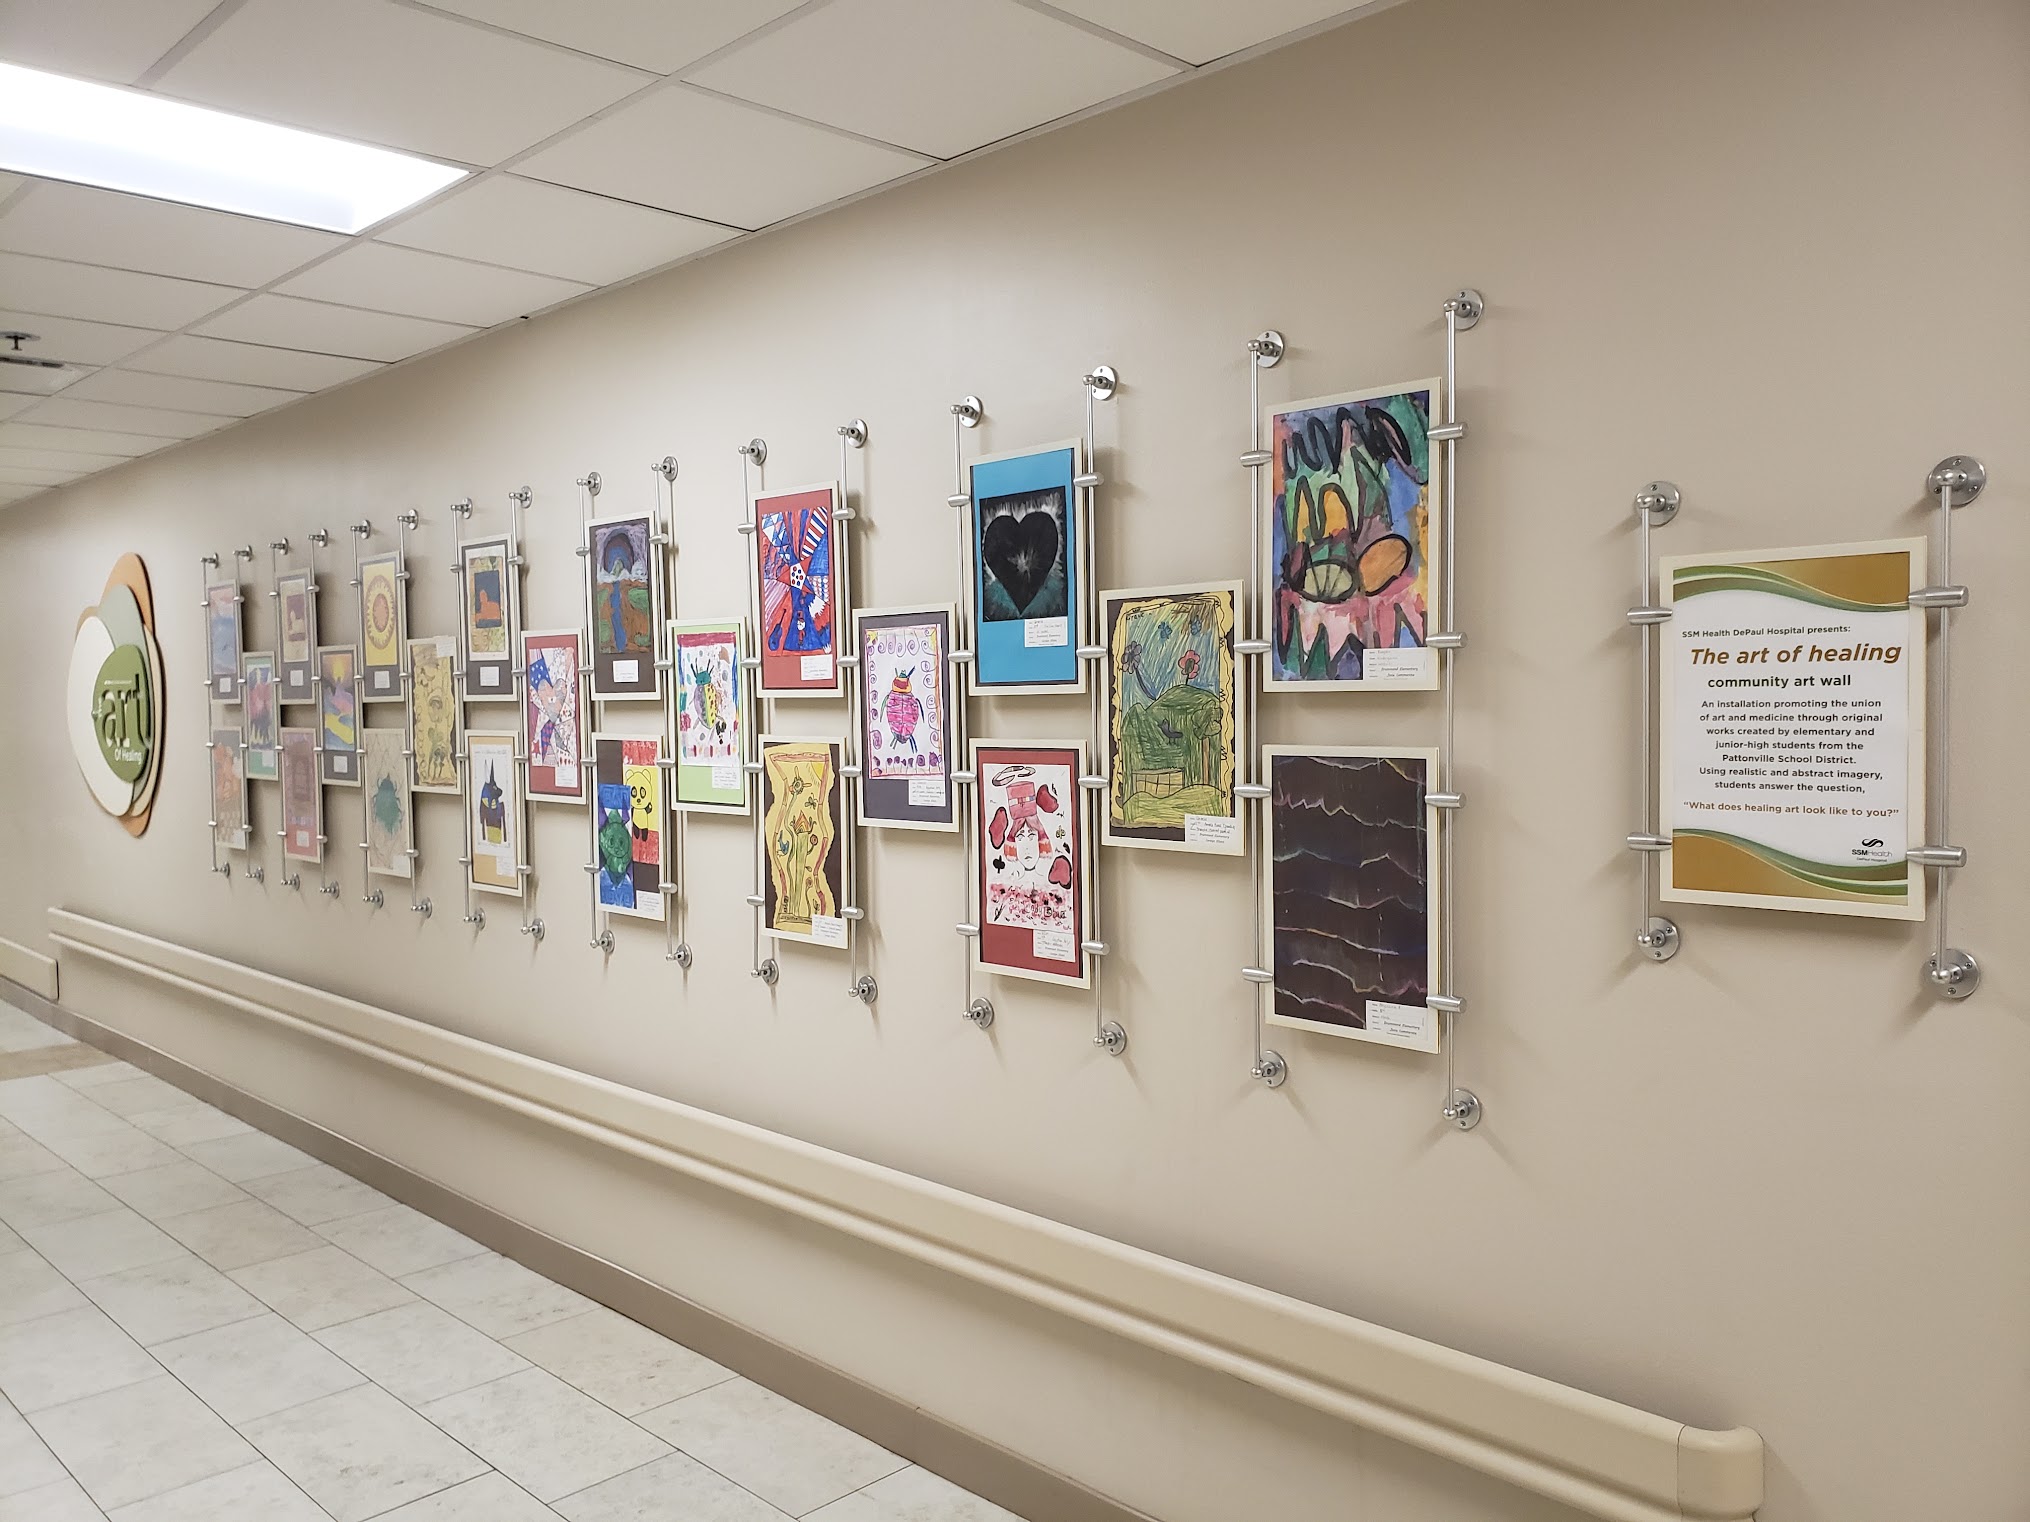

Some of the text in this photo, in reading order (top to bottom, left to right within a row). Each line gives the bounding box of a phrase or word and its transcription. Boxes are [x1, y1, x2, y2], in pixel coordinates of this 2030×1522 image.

[1682, 625, 1851, 638] SSM Health DePaul Hospital presents:
[1691, 643, 1902, 665] The art of healing
[1707, 674, 1851, 689] community art wall
[1701, 699, 1881, 709] An installation promoting the union
[102, 674, 151, 748] art
[1699, 713, 1883, 723] of art and medicine through original
[1706, 727, 1875, 738] works created by elementary and
[1714, 741, 1864, 751] junior-high students from the
[122, 749, 142, 766] Healing
[1722, 754, 1856, 764] Pattonville School District.
[1699, 767, 1883, 780] Using realistic and abstract imagery,
[1714, 781, 1866, 794] students answer the question,
[1718, 802, 1742, 812] does
[1744, 803, 1782, 814] healing
[1785, 804, 1800, 814] art
[1802, 805, 1826, 815] look
[1829, 806, 1848, 816] like
[1851, 807, 1863, 816] to
